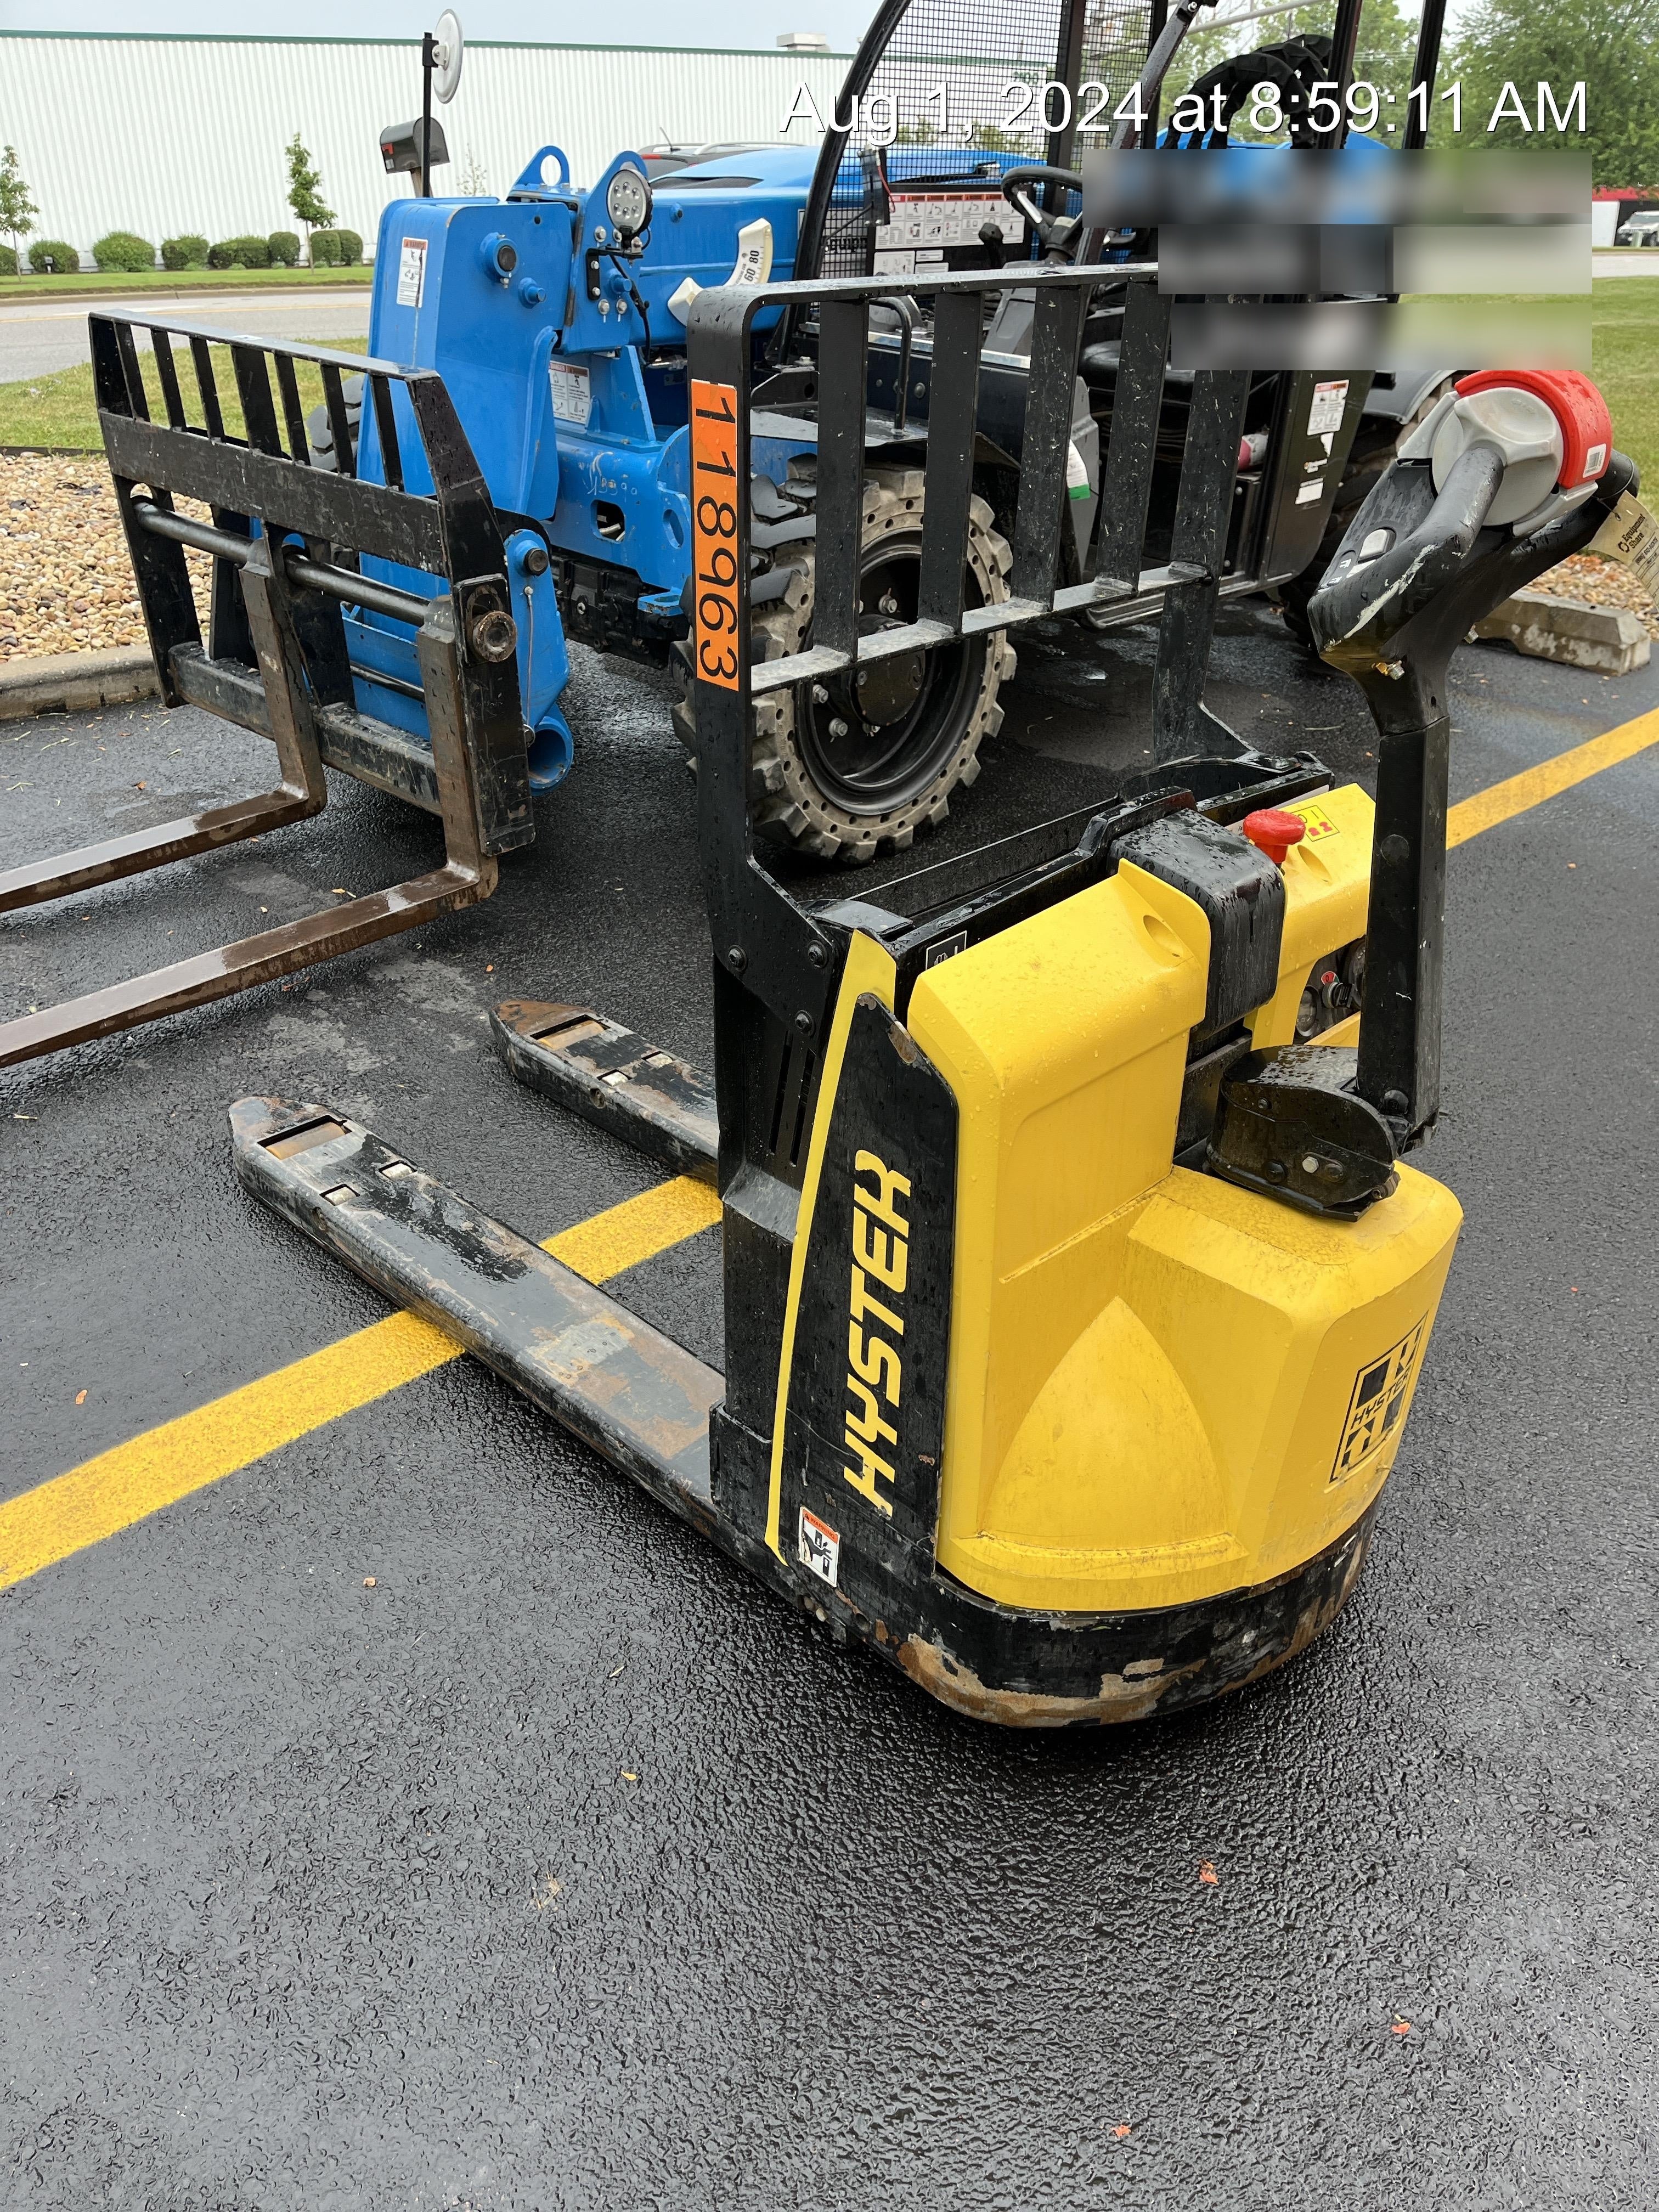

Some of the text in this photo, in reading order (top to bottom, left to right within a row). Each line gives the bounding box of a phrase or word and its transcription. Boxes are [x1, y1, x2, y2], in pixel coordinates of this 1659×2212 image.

[744, 250, 759, 282] 60 80
[695, 396, 738, 681] 118963
[1621, 514, 1645, 543] Equipment
[1629, 532, 1645, 549] Share
[843, 1149, 911, 1521] HYSTER
[1350, 1363, 1412, 1431] HYSTER
[810, 1517, 835, 1540] WARNING
